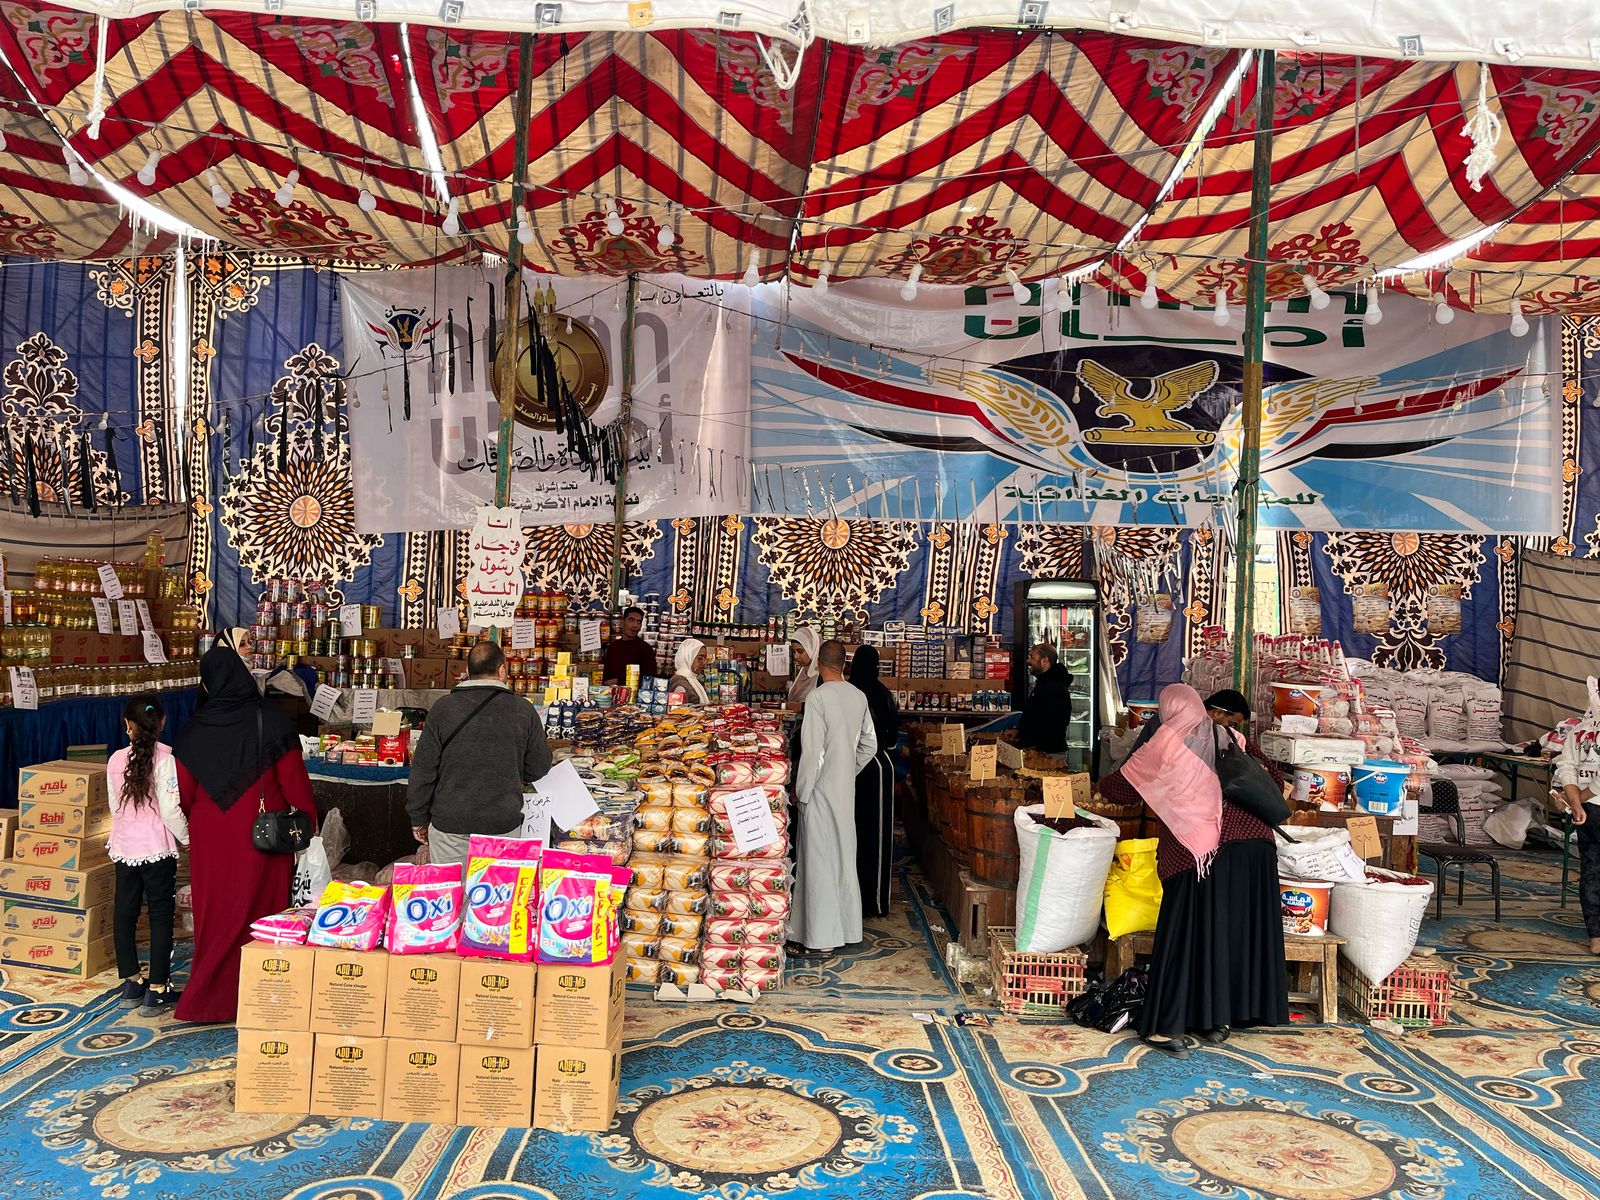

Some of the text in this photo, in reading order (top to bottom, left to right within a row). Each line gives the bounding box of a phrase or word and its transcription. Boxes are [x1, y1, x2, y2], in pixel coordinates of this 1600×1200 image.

[662, 283, 724, 304] بالتعاون
[40, 812, 65, 824] Bahi
[25, 879, 51, 891] Bahi
